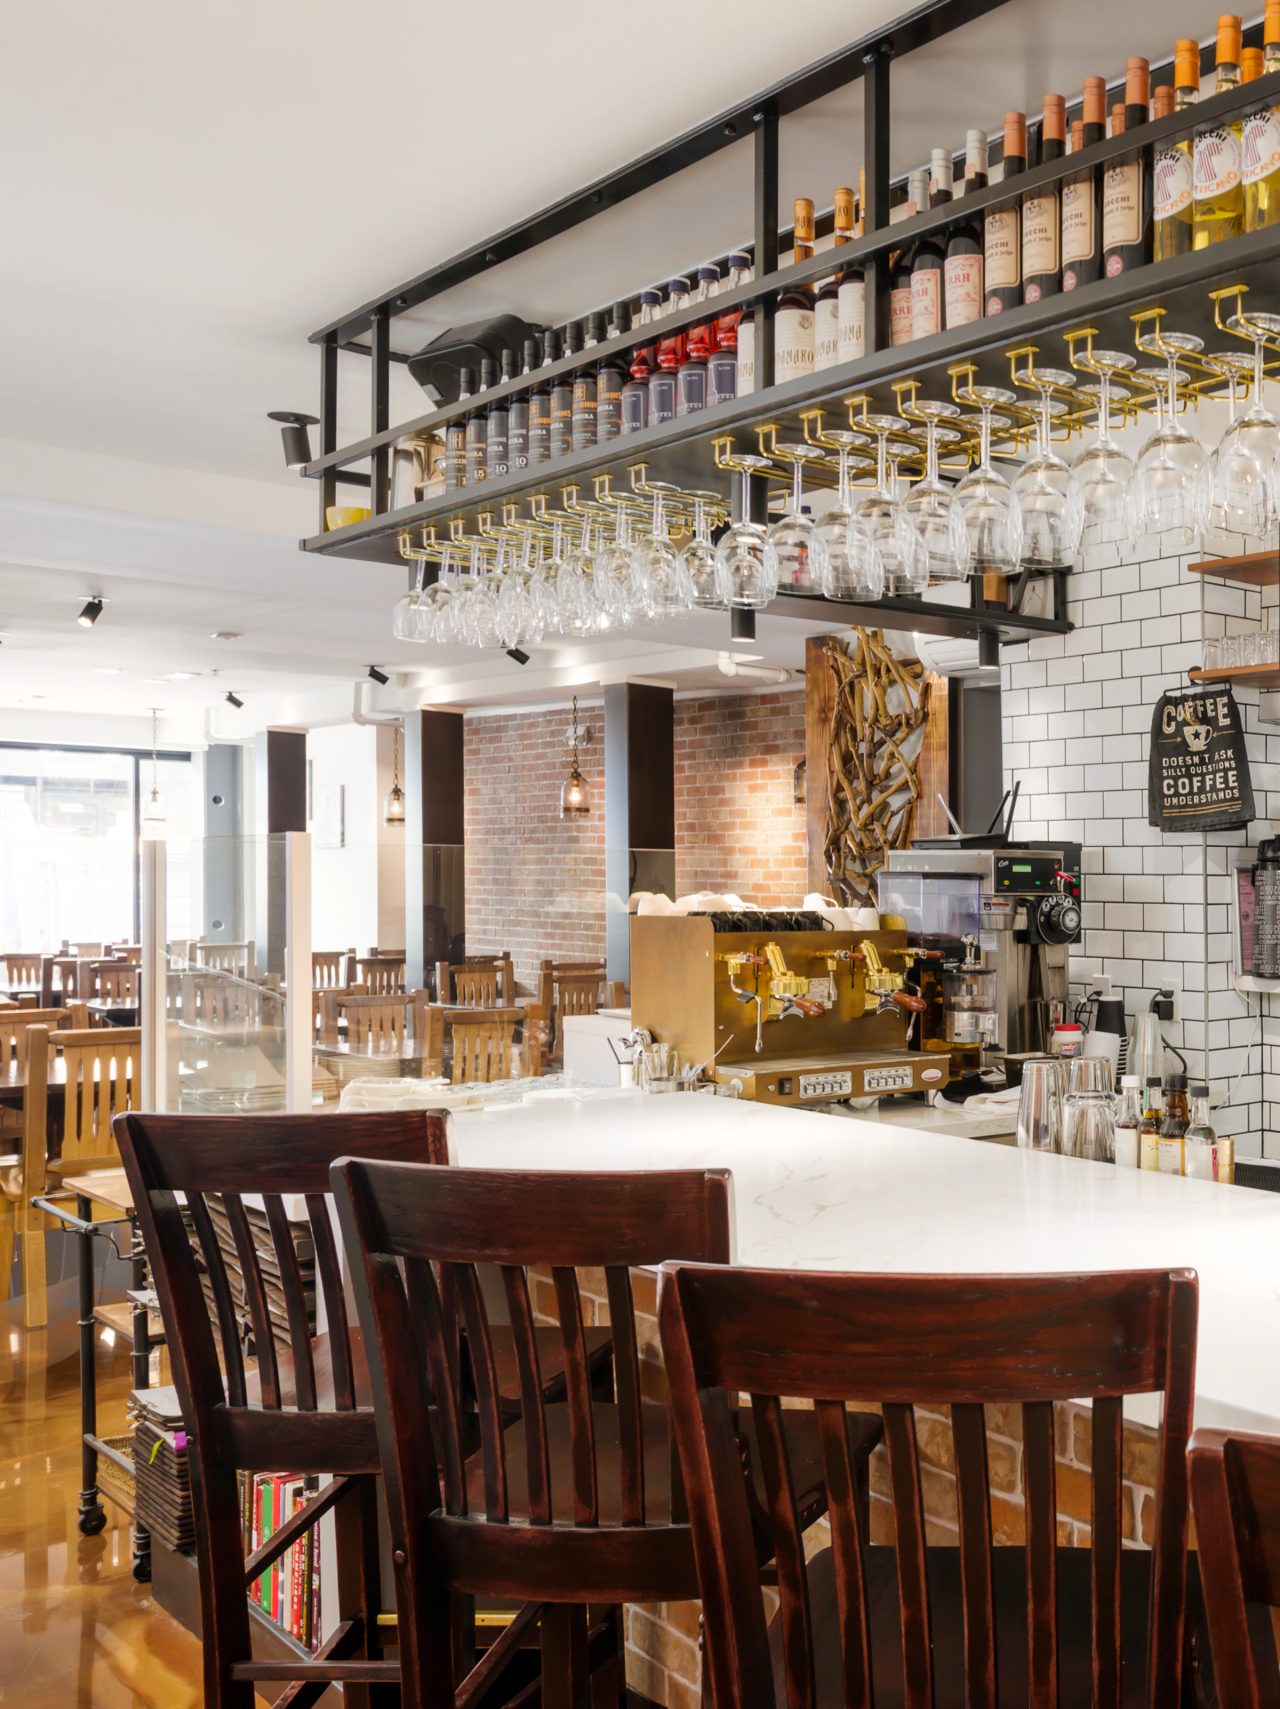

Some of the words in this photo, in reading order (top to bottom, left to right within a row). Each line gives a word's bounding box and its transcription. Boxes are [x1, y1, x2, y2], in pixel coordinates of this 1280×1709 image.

[495, 464, 507, 473] 10
[515, 457, 527, 466] 10
[1162, 696, 1231, 734] COFFEE
[1162, 754, 1210, 767] DOESN'T
[1214, 748, 1234, 760] ASK
[1162, 766, 1187, 777] SILLY
[1190, 760, 1236, 774] QUESTIONS
[1162, 771, 1239, 795] COFFEE
[1164, 789, 1240, 807] UNDERSTANDS
